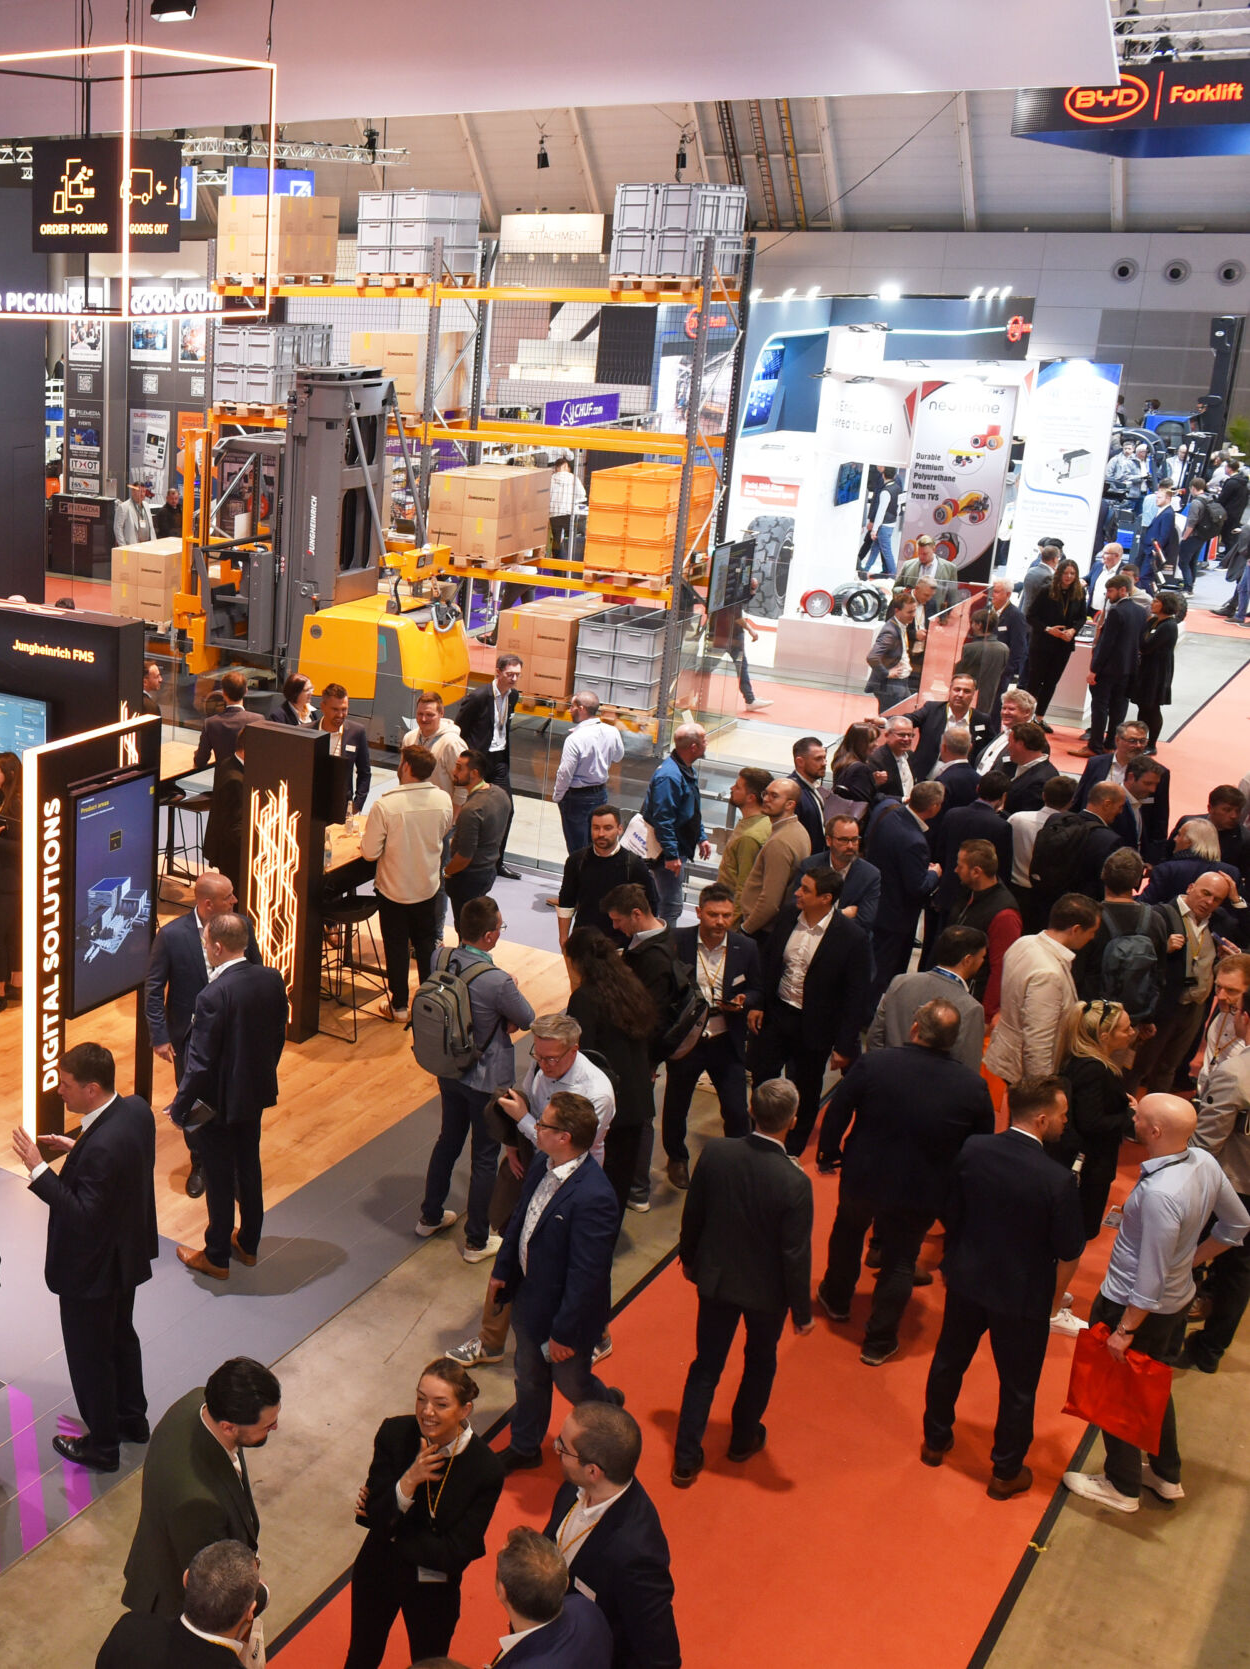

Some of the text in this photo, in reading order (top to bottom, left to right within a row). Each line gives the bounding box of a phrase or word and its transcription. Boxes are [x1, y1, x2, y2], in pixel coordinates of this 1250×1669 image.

[1074, 83, 1244, 108] BYD Forklift
[40, 223, 108, 235] ORDER PICKING
[129, 223, 169, 235] GOODS OUT
[5, 292, 84, 314] PICKING
[130, 293, 183, 315] GOODS
[915, 452, 941, 462] Durable
[914, 462, 944, 472] Premium
[913, 472, 956, 483] Polyurethane
[912, 482, 936, 491] Wheels
[911, 491, 926, 501] from
[306, 495, 318, 556] JUNGHEINRICH
[12, 639, 95, 663] Jungheinrich FMS
[42, 798, 62, 1093] DIGITAL SOLUTIONS
